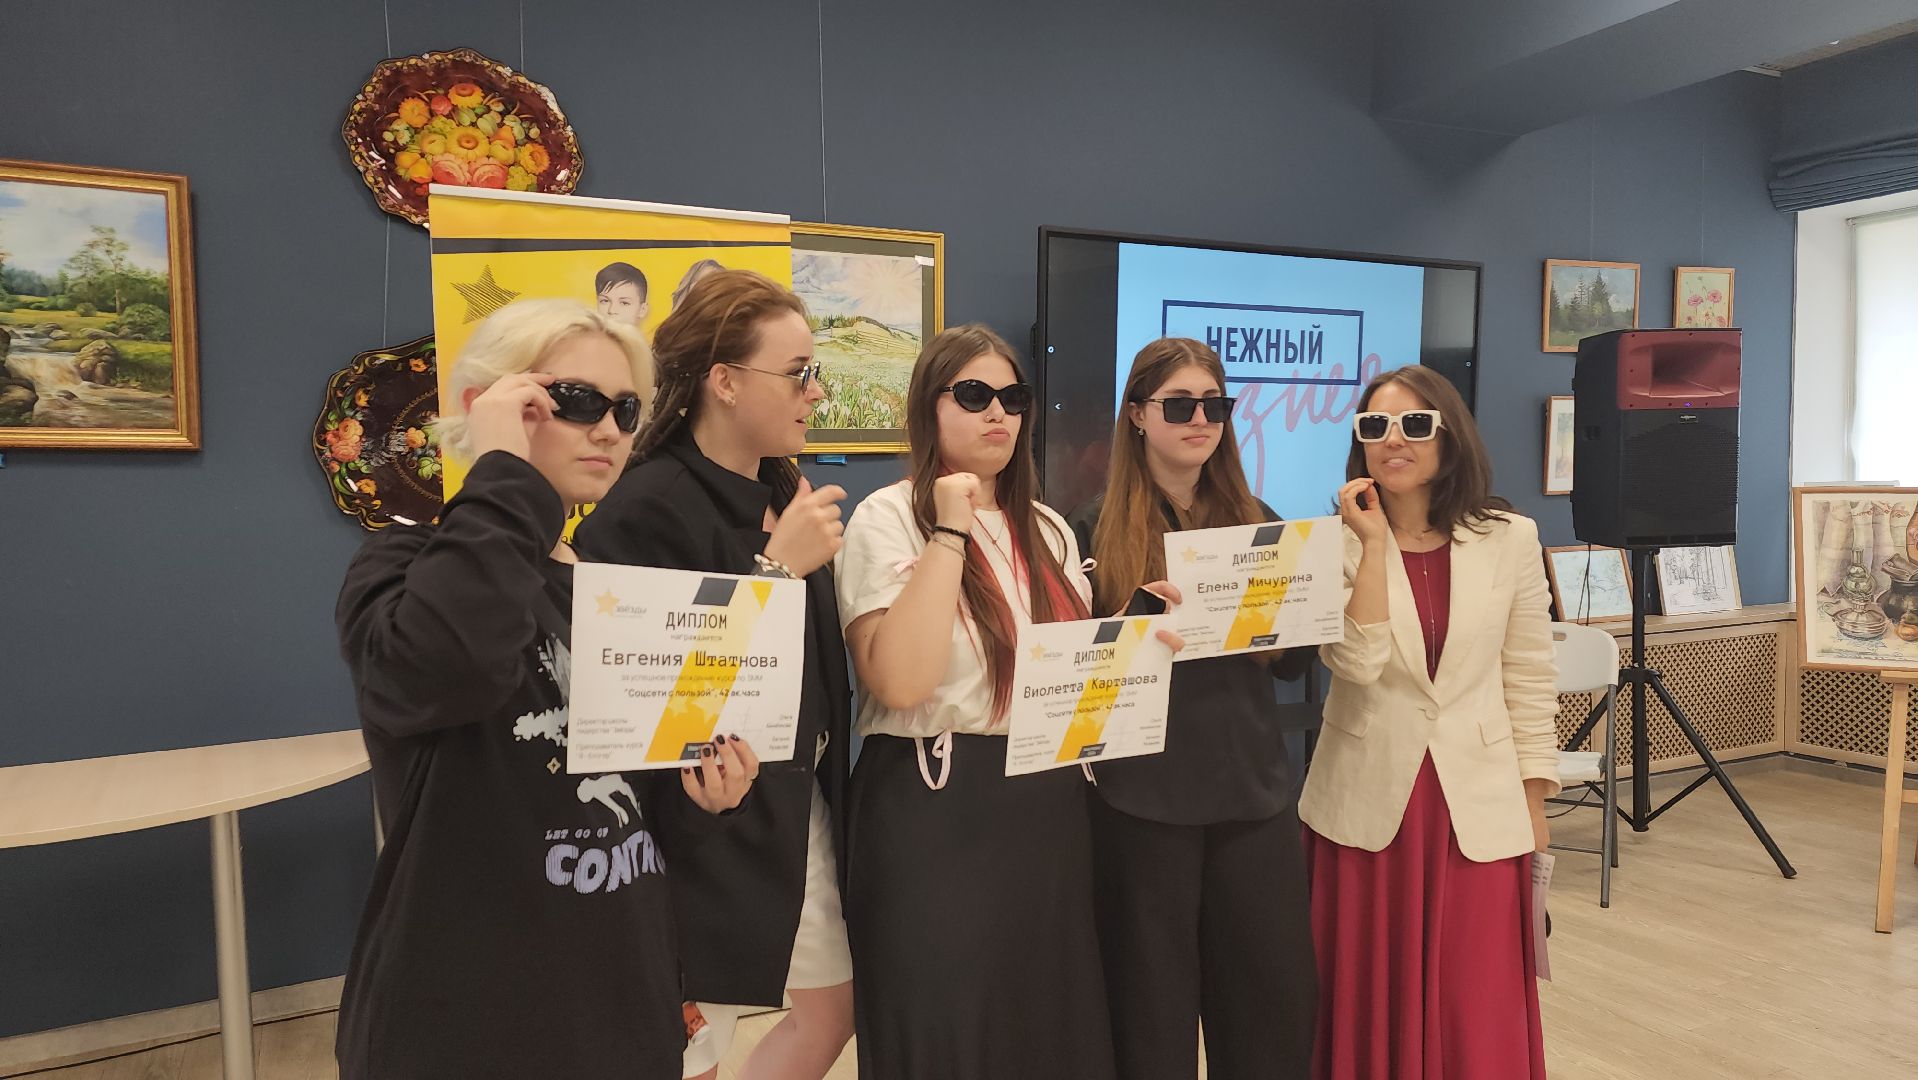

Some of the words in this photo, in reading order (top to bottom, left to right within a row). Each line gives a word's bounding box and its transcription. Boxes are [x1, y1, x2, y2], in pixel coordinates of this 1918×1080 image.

[1206, 323, 1324, 365] НЕЖНЫЙ
[1232, 550, 1279, 567] ДИПЛОМ
[1197, 582, 1239, 594] Елена
[1247, 573, 1313, 588] Мичурина
[665, 611, 727, 631] ДИПЛОМ
[602, 647, 683, 666] Евгения
[695, 650, 778, 668] Штатнова
[1073, 647, 1115, 666] ДИПЛОМ
[719, 688, 730, 697] 42
[1023, 681, 1084, 699] Виолетта
[1091, 674, 1158, 691] Карташова
[575, 828, 591, 839] GO
[545, 829, 666, 894] CONTR
